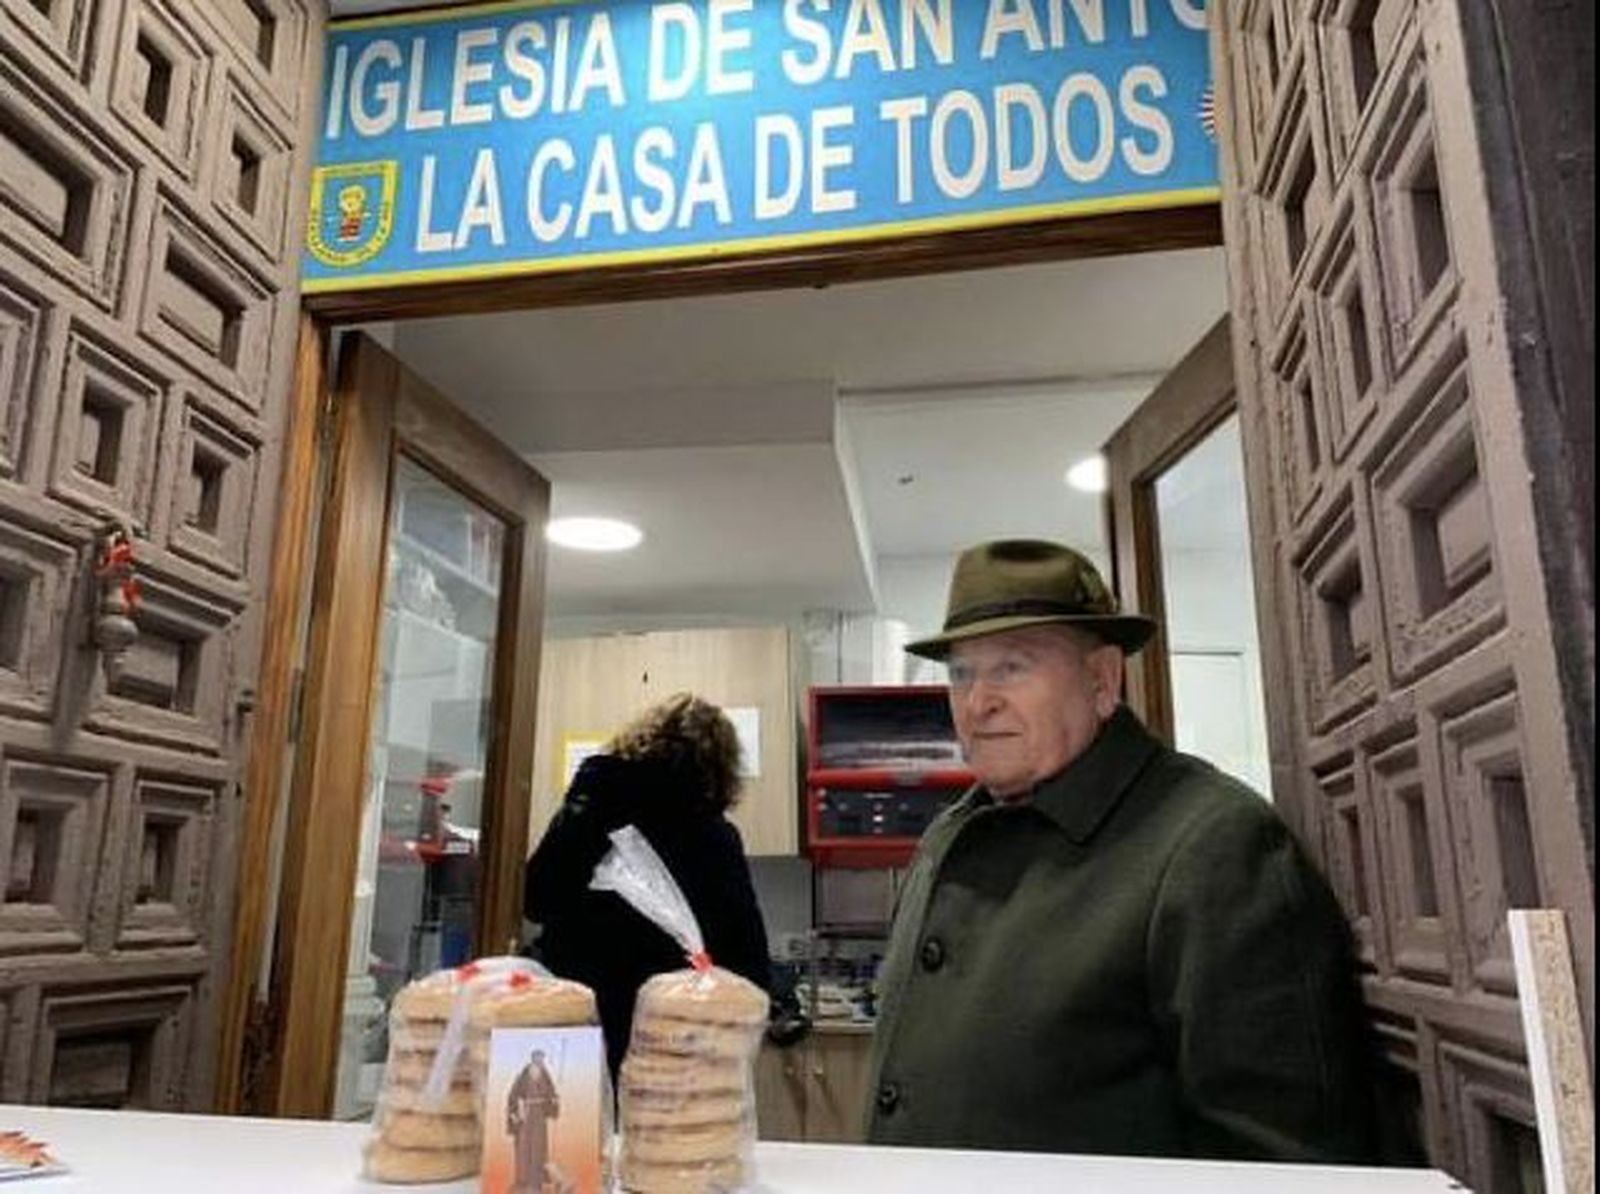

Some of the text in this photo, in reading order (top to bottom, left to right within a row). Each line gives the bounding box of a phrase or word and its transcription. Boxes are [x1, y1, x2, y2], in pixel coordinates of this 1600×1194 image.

[327, 0, 1207, 139] IGLESIA DE SAN AN
[416, 148, 506, 252] LA
[527, 122, 732, 243] CASA
[755, 106, 857, 219] DE
[881, 65, 1174, 203] TODOS
